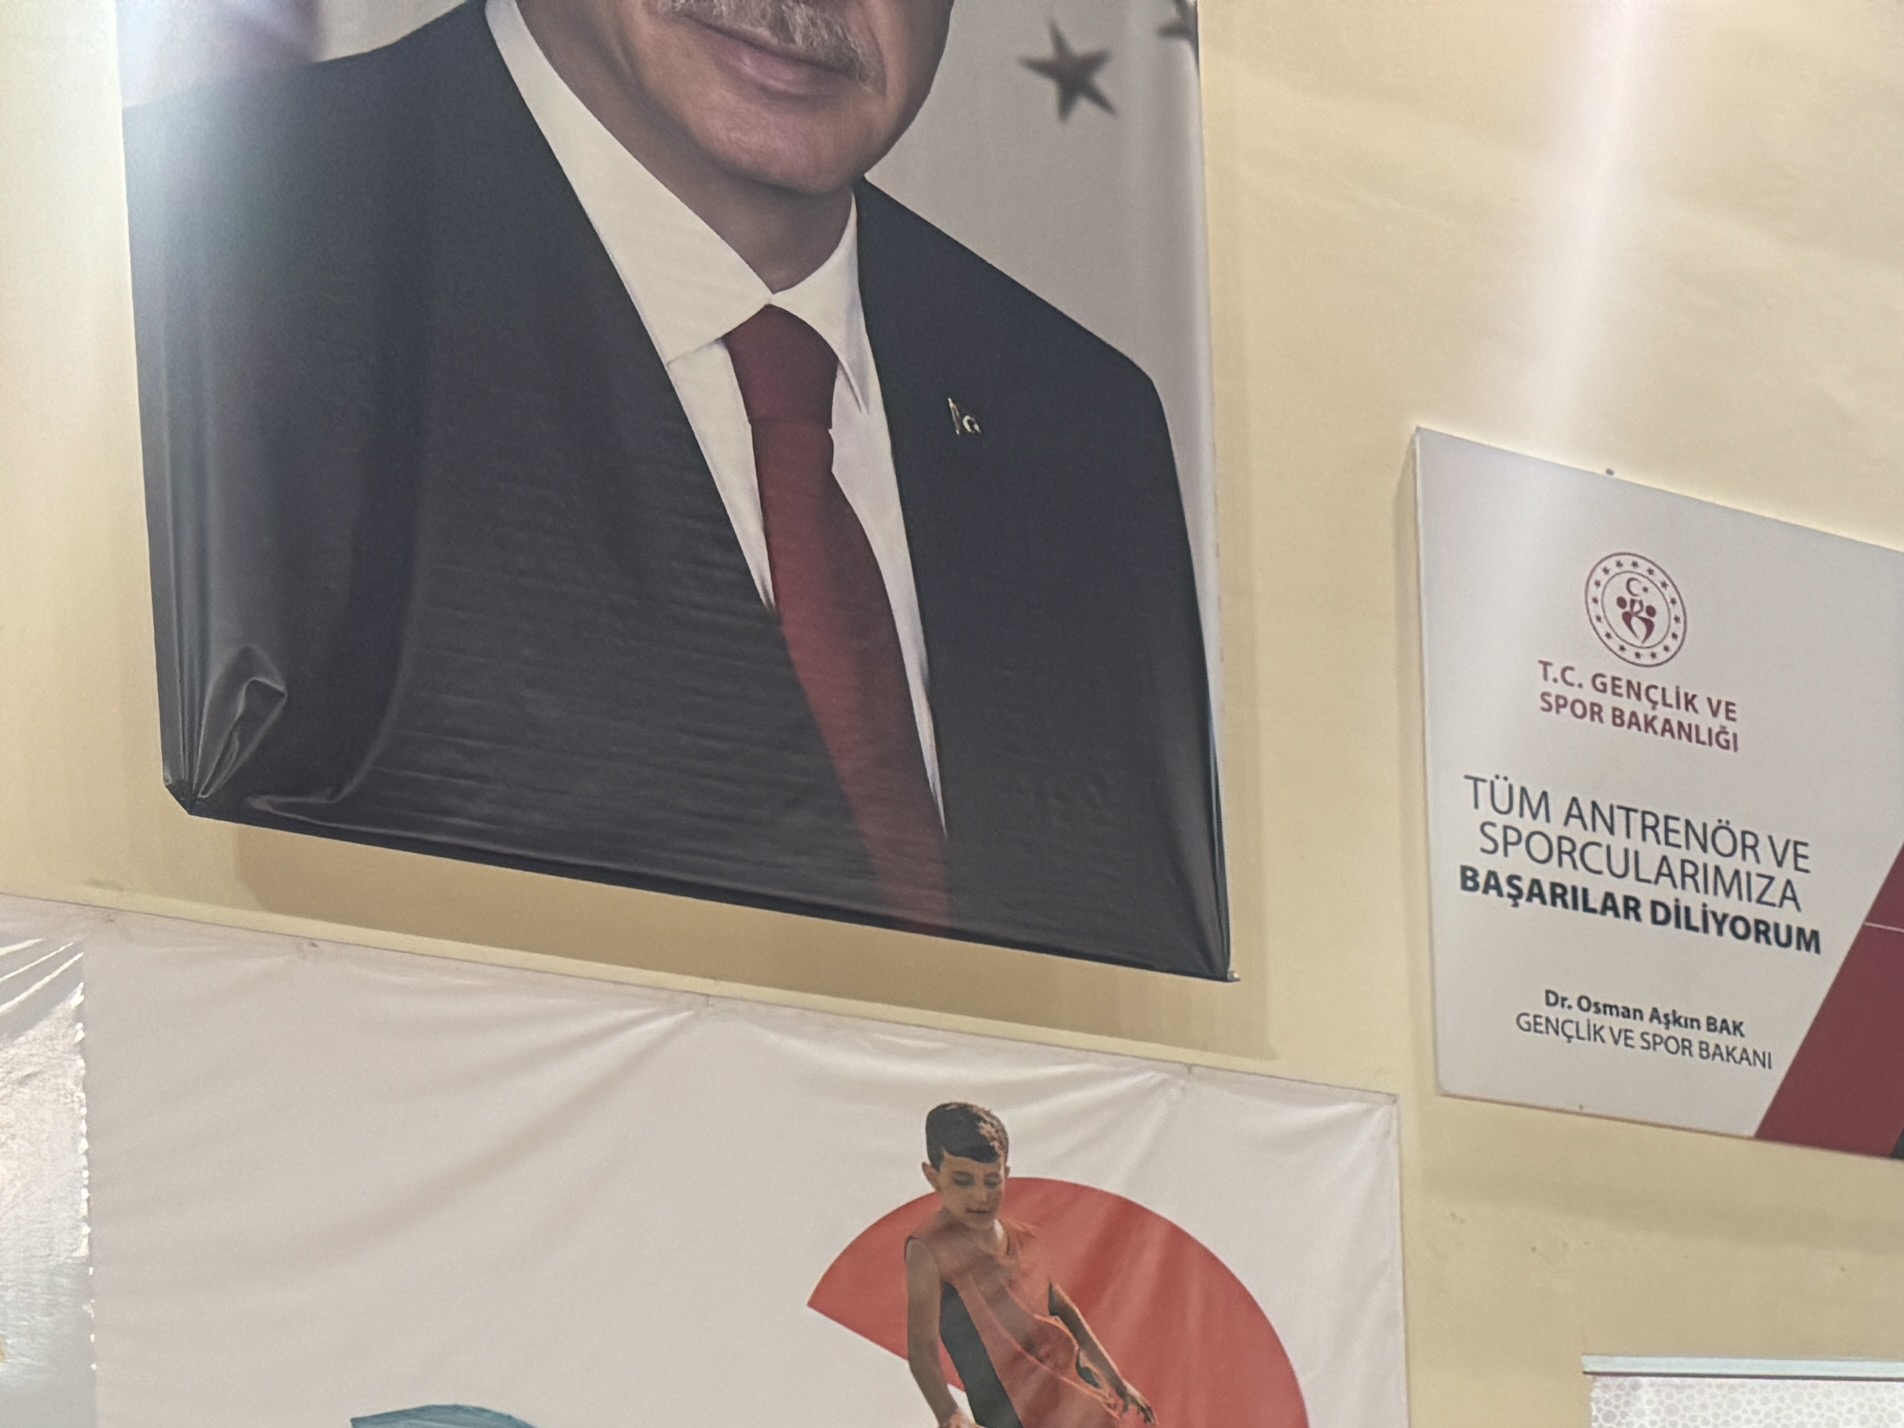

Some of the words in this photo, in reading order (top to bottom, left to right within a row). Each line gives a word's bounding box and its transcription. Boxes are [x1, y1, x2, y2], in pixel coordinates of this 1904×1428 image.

[1538, 660, 1584, 689] T.C.
[1591, 673, 1699, 714] GENÇLİK
[1707, 696, 1737, 722] VE
[1540, 691, 1604, 724] SPOR
[1611, 706, 1738, 753] BAKANLIĞI
[1464, 774, 1551, 824] TÜM
[1564, 797, 1761, 864] ANTRENÖR
[1768, 835, 1811, 874] VE
[1479, 821, 1802, 913] SPORCULARIMIZA
[1459, 865, 1643, 923] BAŞARILAR
[1650, 897, 1822, 955] DİLİYORUM
[1516, 1011, 1606, 1044] GENÇLİK
[1608, 1028, 1635, 1049] VE
[1640, 1031, 1694, 1057] SPOR
[1699, 1041, 1773, 1071] BAKANI
[1544, 989, 1574, 1010] Dr.
[1577, 995, 1645, 1022] Osman
[1648, 1007, 1702, 1033] Aşkın
[1705, 1016, 1746, 1038] BAK
